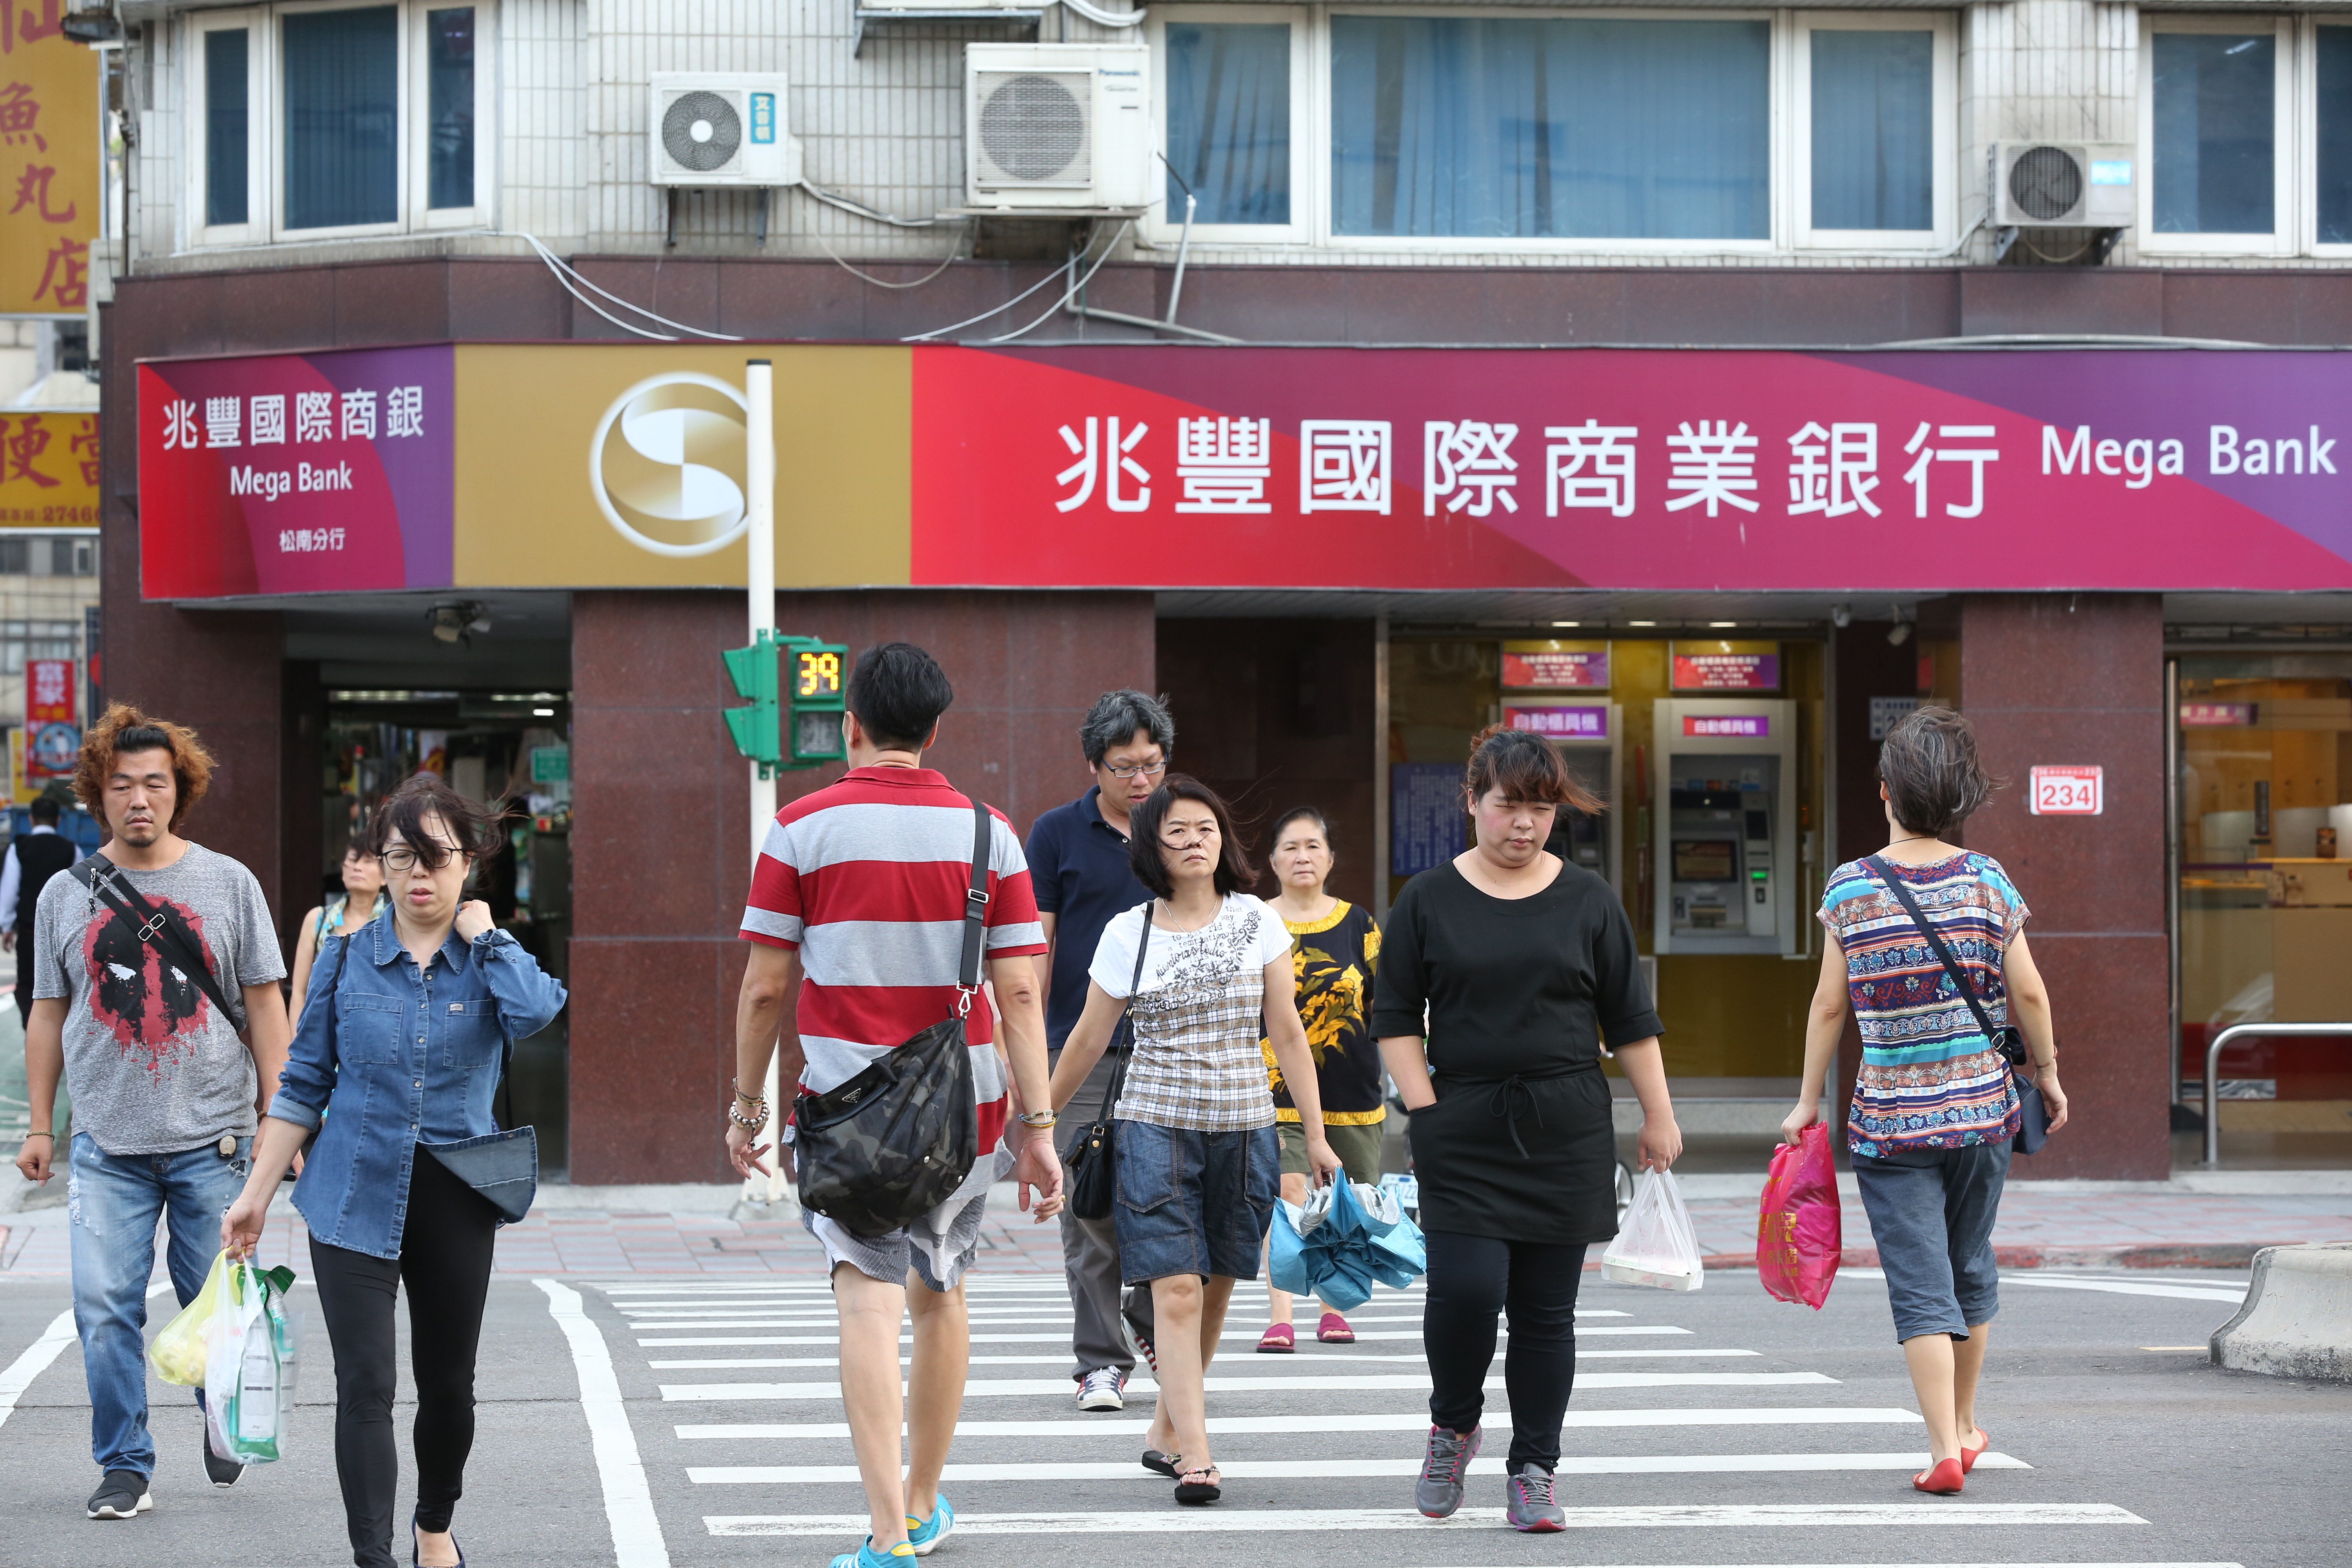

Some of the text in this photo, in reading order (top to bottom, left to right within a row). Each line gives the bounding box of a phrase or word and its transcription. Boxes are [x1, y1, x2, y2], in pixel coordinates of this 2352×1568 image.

[163, 386, 424, 450] 兆豐國際商銀
[1055, 416, 1999, 519] 兆豐國際商業銀行
[2042, 424, 2337, 489] Mega Bank
[231, 461, 352, 501] Mega Bank
[279, 528, 345, 552] 松南分行
[801, 653, 839, 695] 39
[2043, 785, 2090, 806] 234
